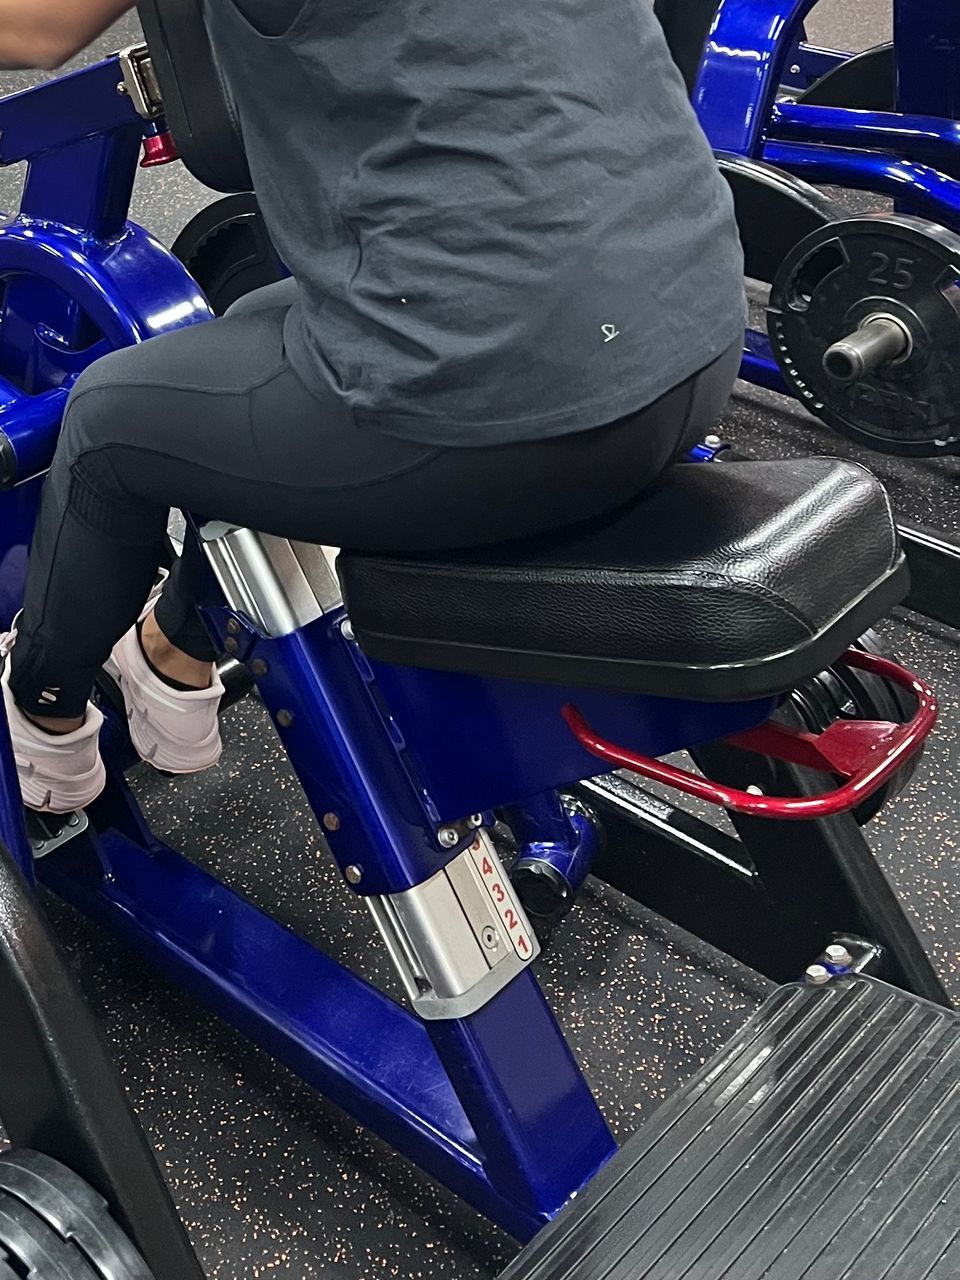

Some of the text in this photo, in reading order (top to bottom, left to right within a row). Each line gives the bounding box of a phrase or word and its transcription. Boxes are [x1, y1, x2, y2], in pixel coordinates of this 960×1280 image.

[868, 251, 914, 290] 25
[481, 856, 493, 875] 4
[491, 883, 505, 903] 3
[504, 908, 518, 930] 2
[517, 934, 529, 953] 1
